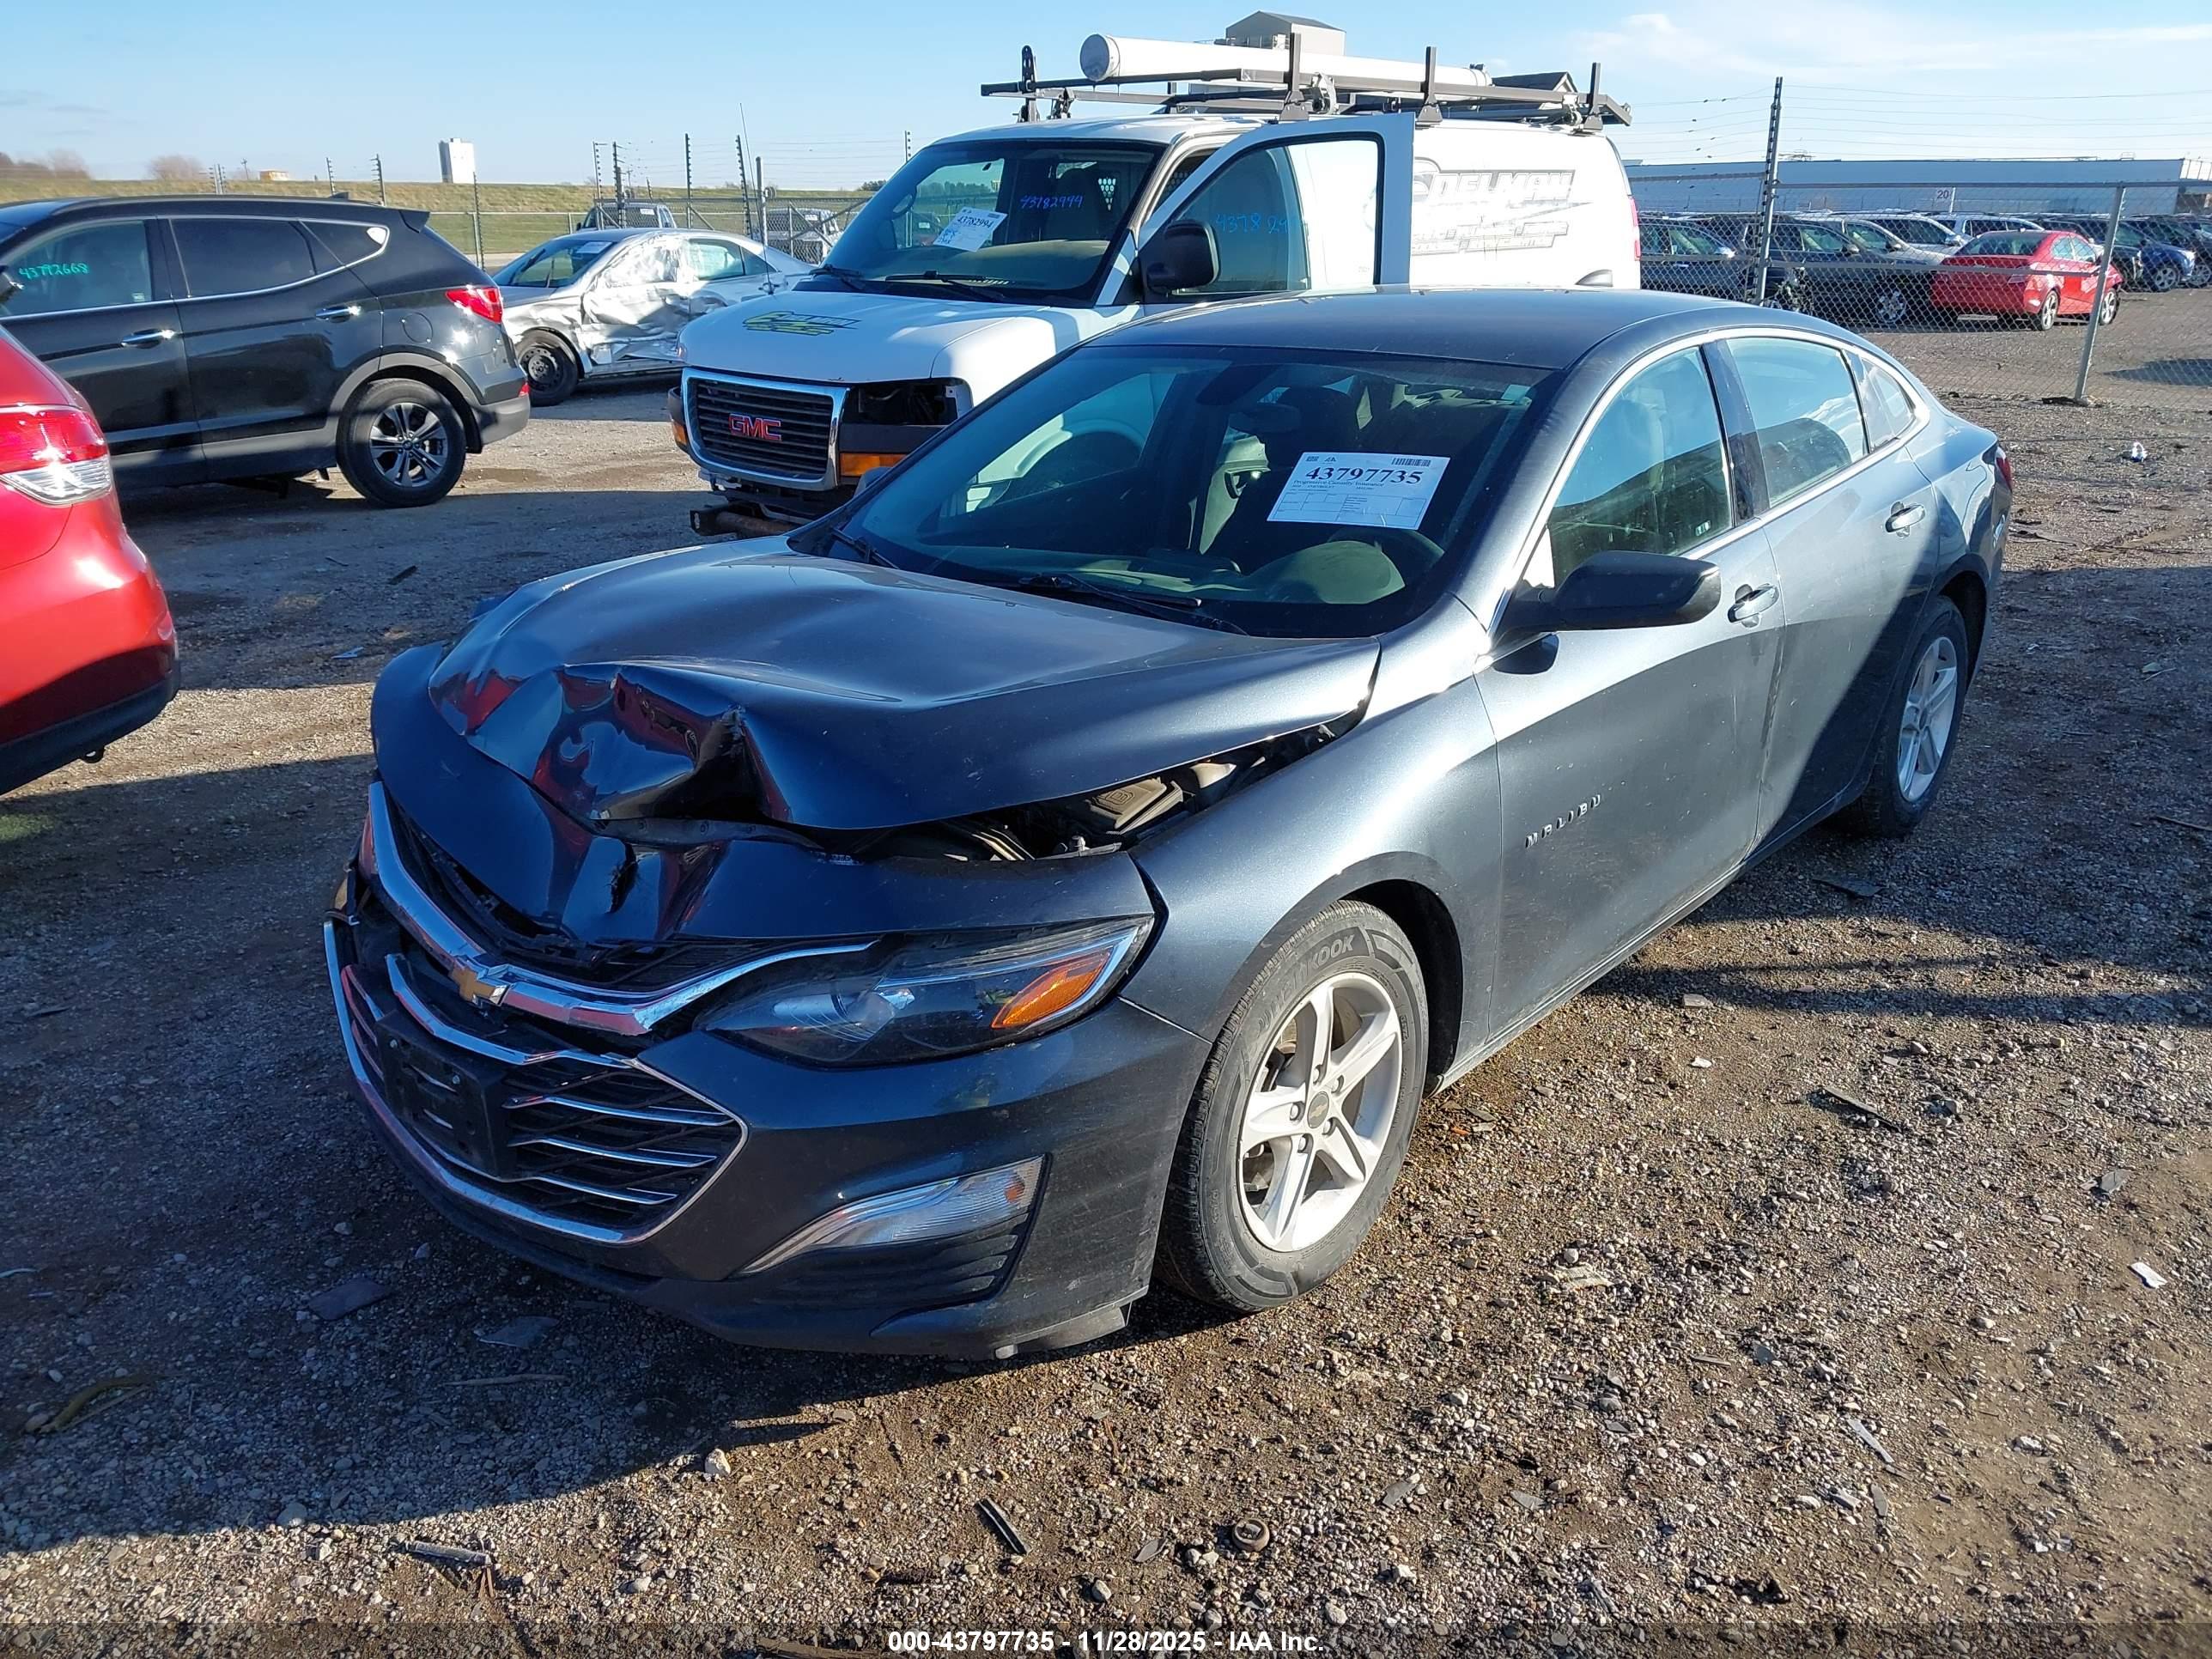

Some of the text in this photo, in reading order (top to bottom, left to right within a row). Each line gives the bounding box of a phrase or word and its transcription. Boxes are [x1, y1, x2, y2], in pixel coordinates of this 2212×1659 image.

[1937, 190, 1949, 198] 20
[729, 413, 782, 441] GMC
[1305, 466, 1424, 484] 43797735
[1525, 794, 1601, 848] MALIBU
